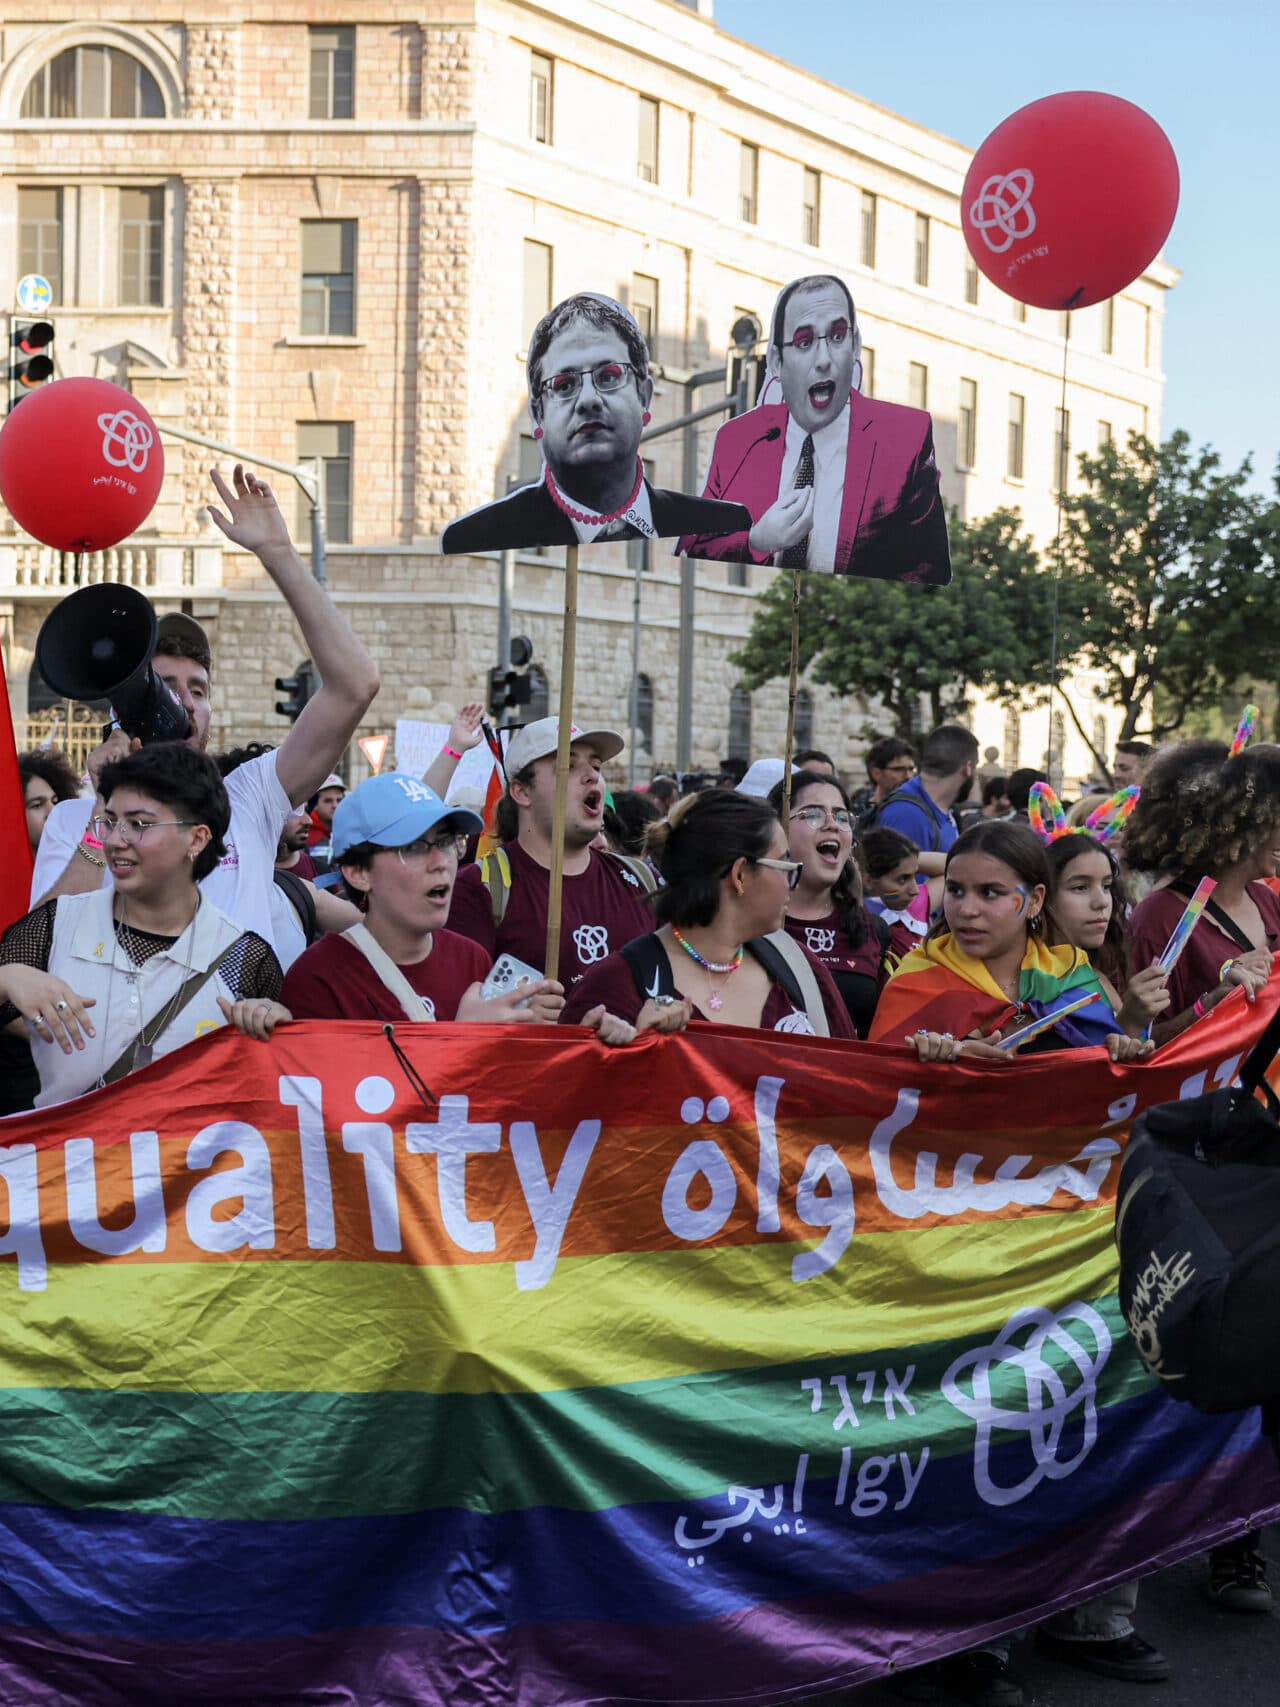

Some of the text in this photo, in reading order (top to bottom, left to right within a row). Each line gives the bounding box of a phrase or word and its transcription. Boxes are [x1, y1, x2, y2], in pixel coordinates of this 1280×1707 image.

[393, 777, 433, 803] LA
[801, 1364, 916, 1431] איגי
[834, 1446, 930, 1517] Igy
